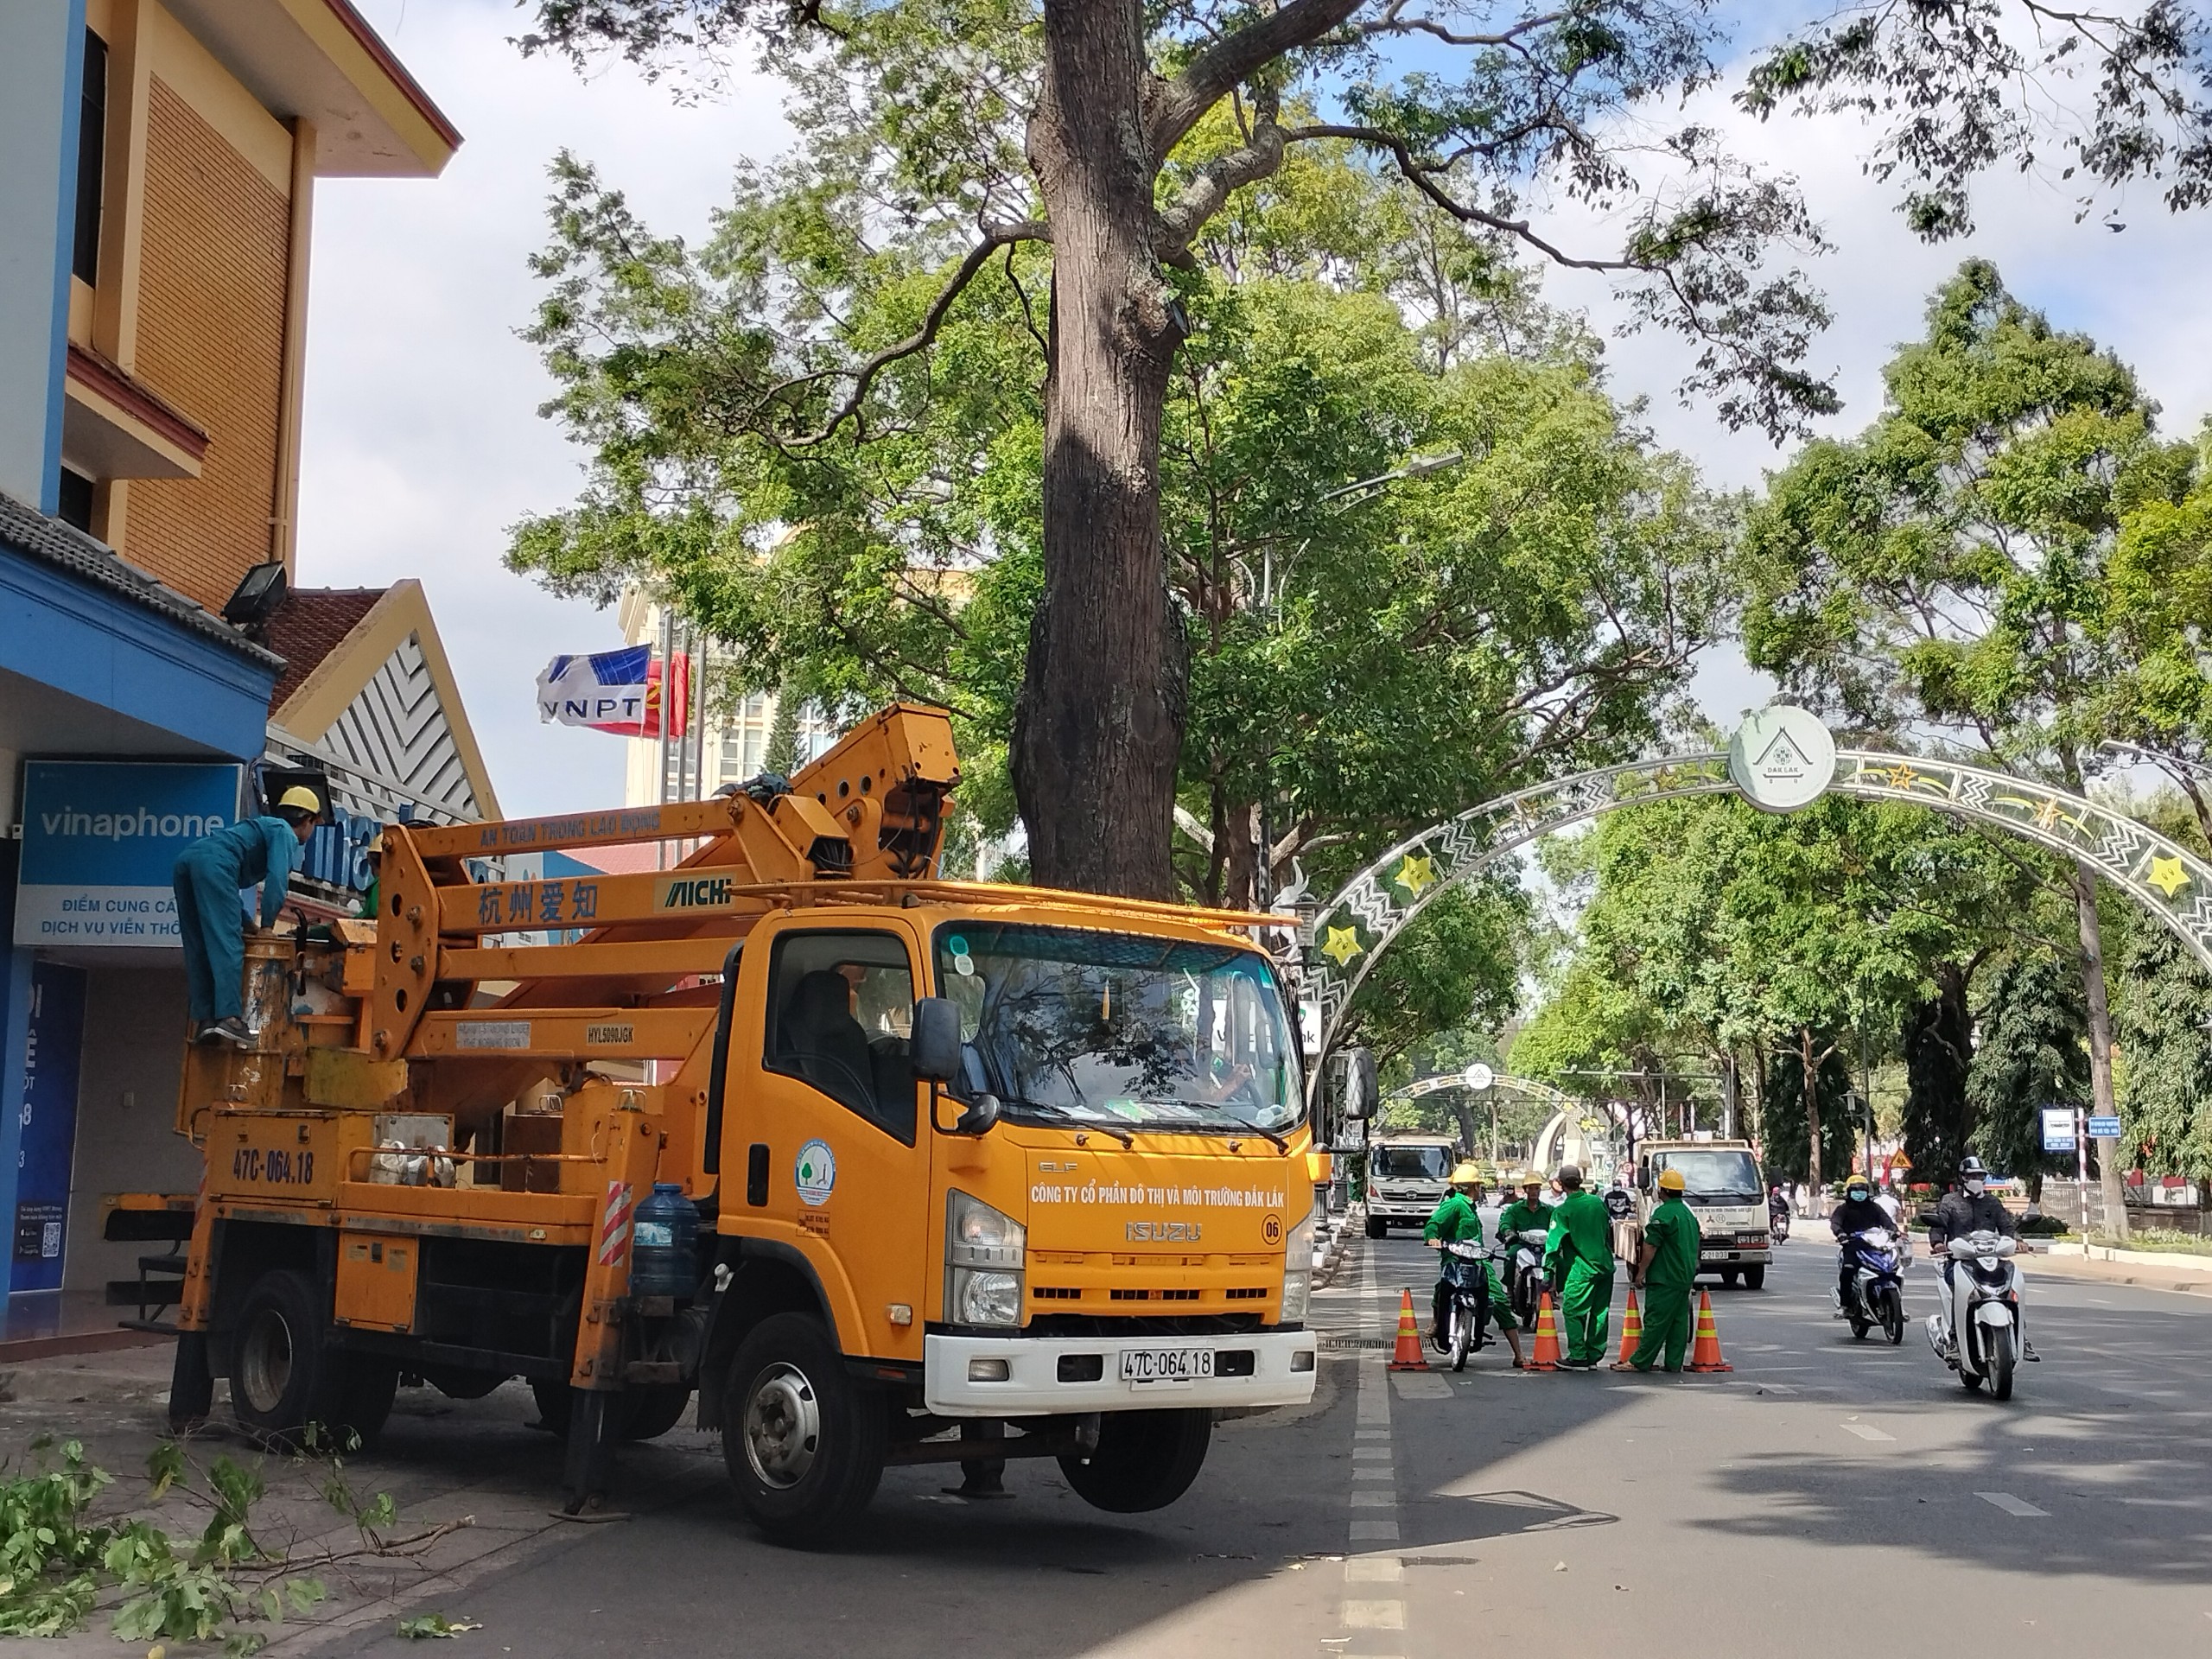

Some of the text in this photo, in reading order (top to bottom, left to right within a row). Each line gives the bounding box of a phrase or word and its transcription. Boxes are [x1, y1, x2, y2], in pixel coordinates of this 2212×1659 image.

[543, 698, 641, 719] VNPT
[41, 805, 225, 842] vinaphone
[480, 829, 498, 846] AN
[589, 816, 617, 836] LAO
[62, 893, 100, 912] ĐIỂM
[105, 899, 149, 913] CUNG
[478, 880, 599, 925] 杭州爱知
[664, 879, 732, 908] AICHI
[41, 921, 79, 936] DỊCH
[84, 922, 105, 936] VỤ
[110, 917, 145, 935] VIỄN
[233, 1148, 314, 1185] 47C-064.18
[1039, 1161, 1078, 1173] ELF
[1031, 1181, 1062, 1203] CÔNG
[1064, 1186, 1078, 1203] TY
[1080, 1178, 1096, 1204] CỔ
[1098, 1179, 1128, 1204] PHẦN
[1147, 1187, 1165, 1208] THỊ
[1166, 1184, 1180, 1205] VÀ
[1183, 1185, 1202, 1205] MÔI
[1204, 1186, 1243, 1207] TRƯỜNG
[1244, 1184, 1265, 1208] ĐẮK
[1266, 1185, 1285, 1208] LẮK
[1126, 1222, 1203, 1243] ISUZU
[1266, 1221, 1279, 1238] 06
[1124, 1351, 1211, 1377] 47C-064.18
